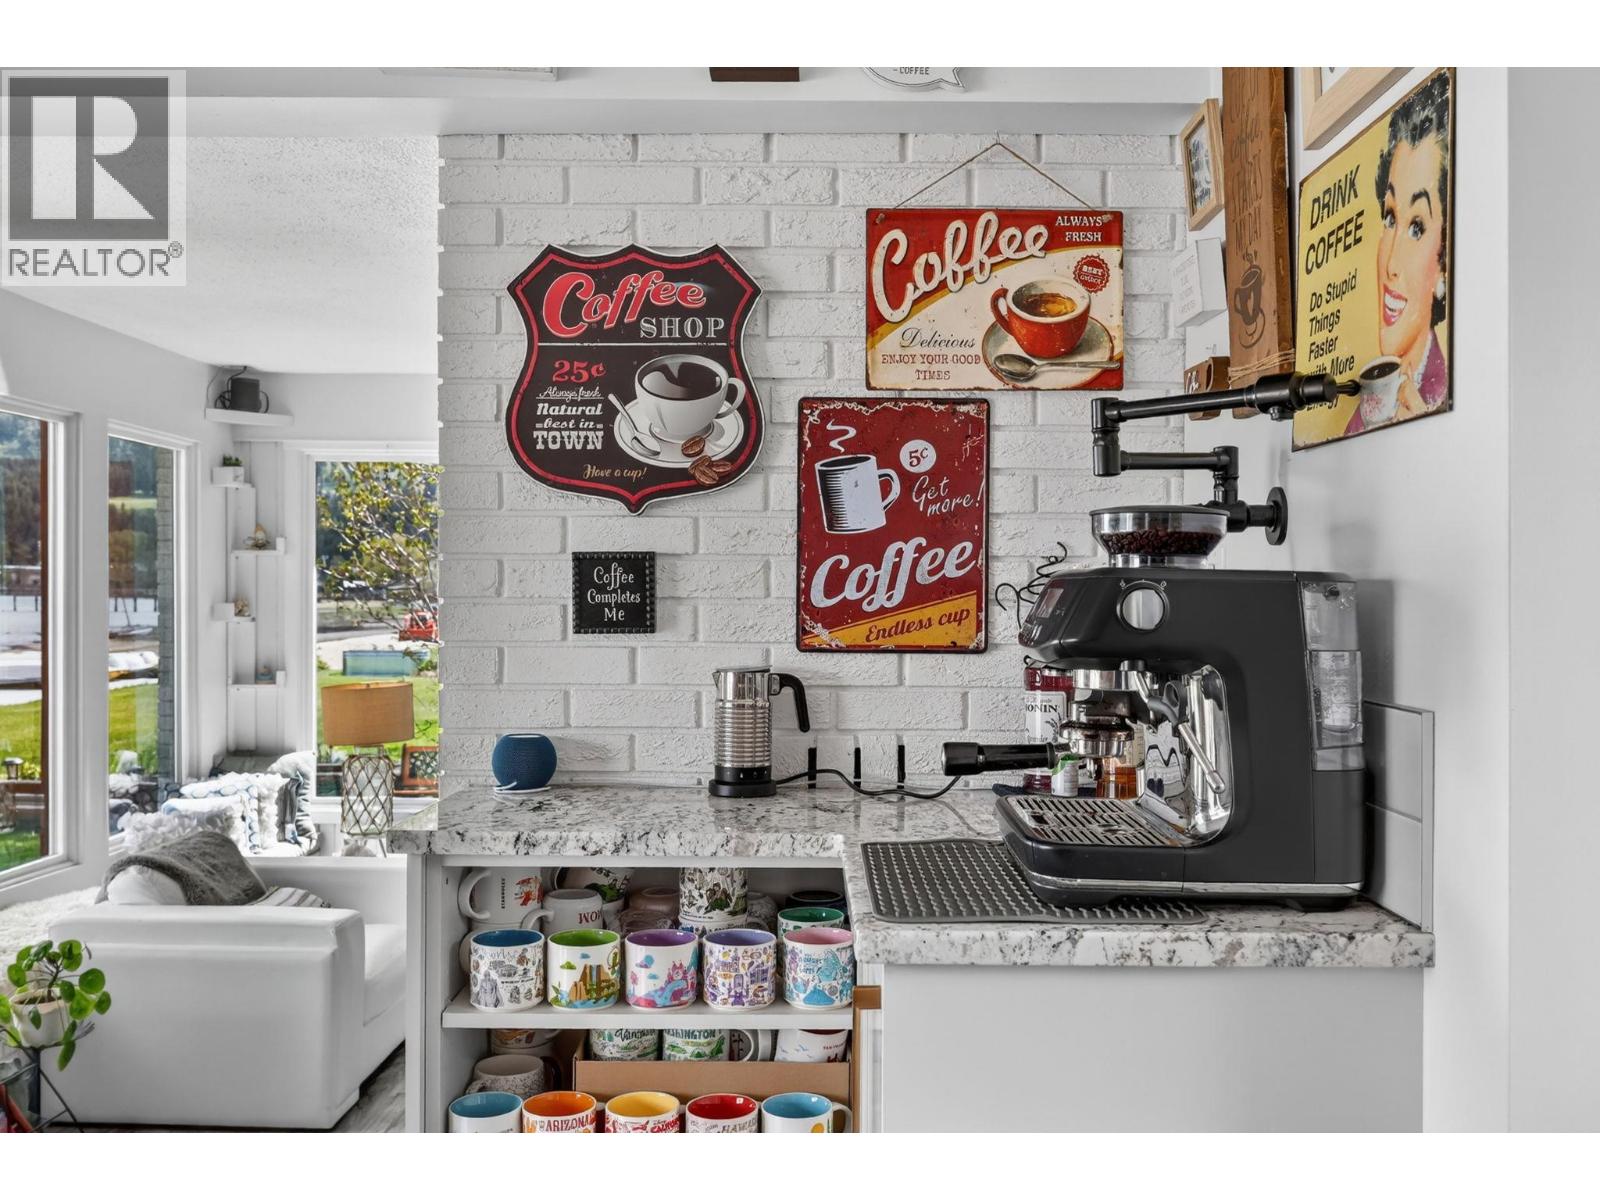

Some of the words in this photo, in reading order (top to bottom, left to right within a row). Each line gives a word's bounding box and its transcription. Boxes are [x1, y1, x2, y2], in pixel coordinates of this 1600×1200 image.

[899, 66, 930, 75] COFFEE
[1310, 163, 1361, 230] DRINK
[1055, 215, 1103, 227] ALWAYS
[1065, 231, 1102, 242] FRESH
[1304, 208, 1365, 275] COFFEE
[872, 211, 1049, 323] Coffee
[1309, 291, 1323, 313] Do
[1325, 267, 1358, 304] Stupid
[542, 270, 707, 338] Coffee
[640, 316, 725, 339] SHOP
[1308, 307, 1341, 337] Things
[900, 326, 976, 349] Delicious
[1307, 334, 1339, 362] Faster
[881, 353, 918, 366] ENJOY
[920, 353, 951, 366] YOUR
[951, 353, 982, 366] GOOD
[1330, 354, 1355, 377] More
[552, 359, 607, 384] 25¢
[914, 368, 951, 381] TIMES
[539, 385, 578, 403] Always
[536, 402, 604, 415] Natural
[543, 417, 576, 429] best
[578, 418, 596, 429] in
[533, 430, 605, 450] TOWN
[583, 463, 613, 480] Have
[614, 468, 623, 477] a
[623, 466, 648, 483] cup!
[912, 475, 950, 512] Get
[927, 479, 986, 517] more!
[593, 561, 635, 591] Coffee
[810, 536, 977, 612] Coffee
[587, 588, 641, 608] Completes
[603, 607, 625, 622] Me
[865, 614, 933, 643] Endless
[937, 605, 971, 627] cup
[1026, 703, 1058, 713] ONIN
